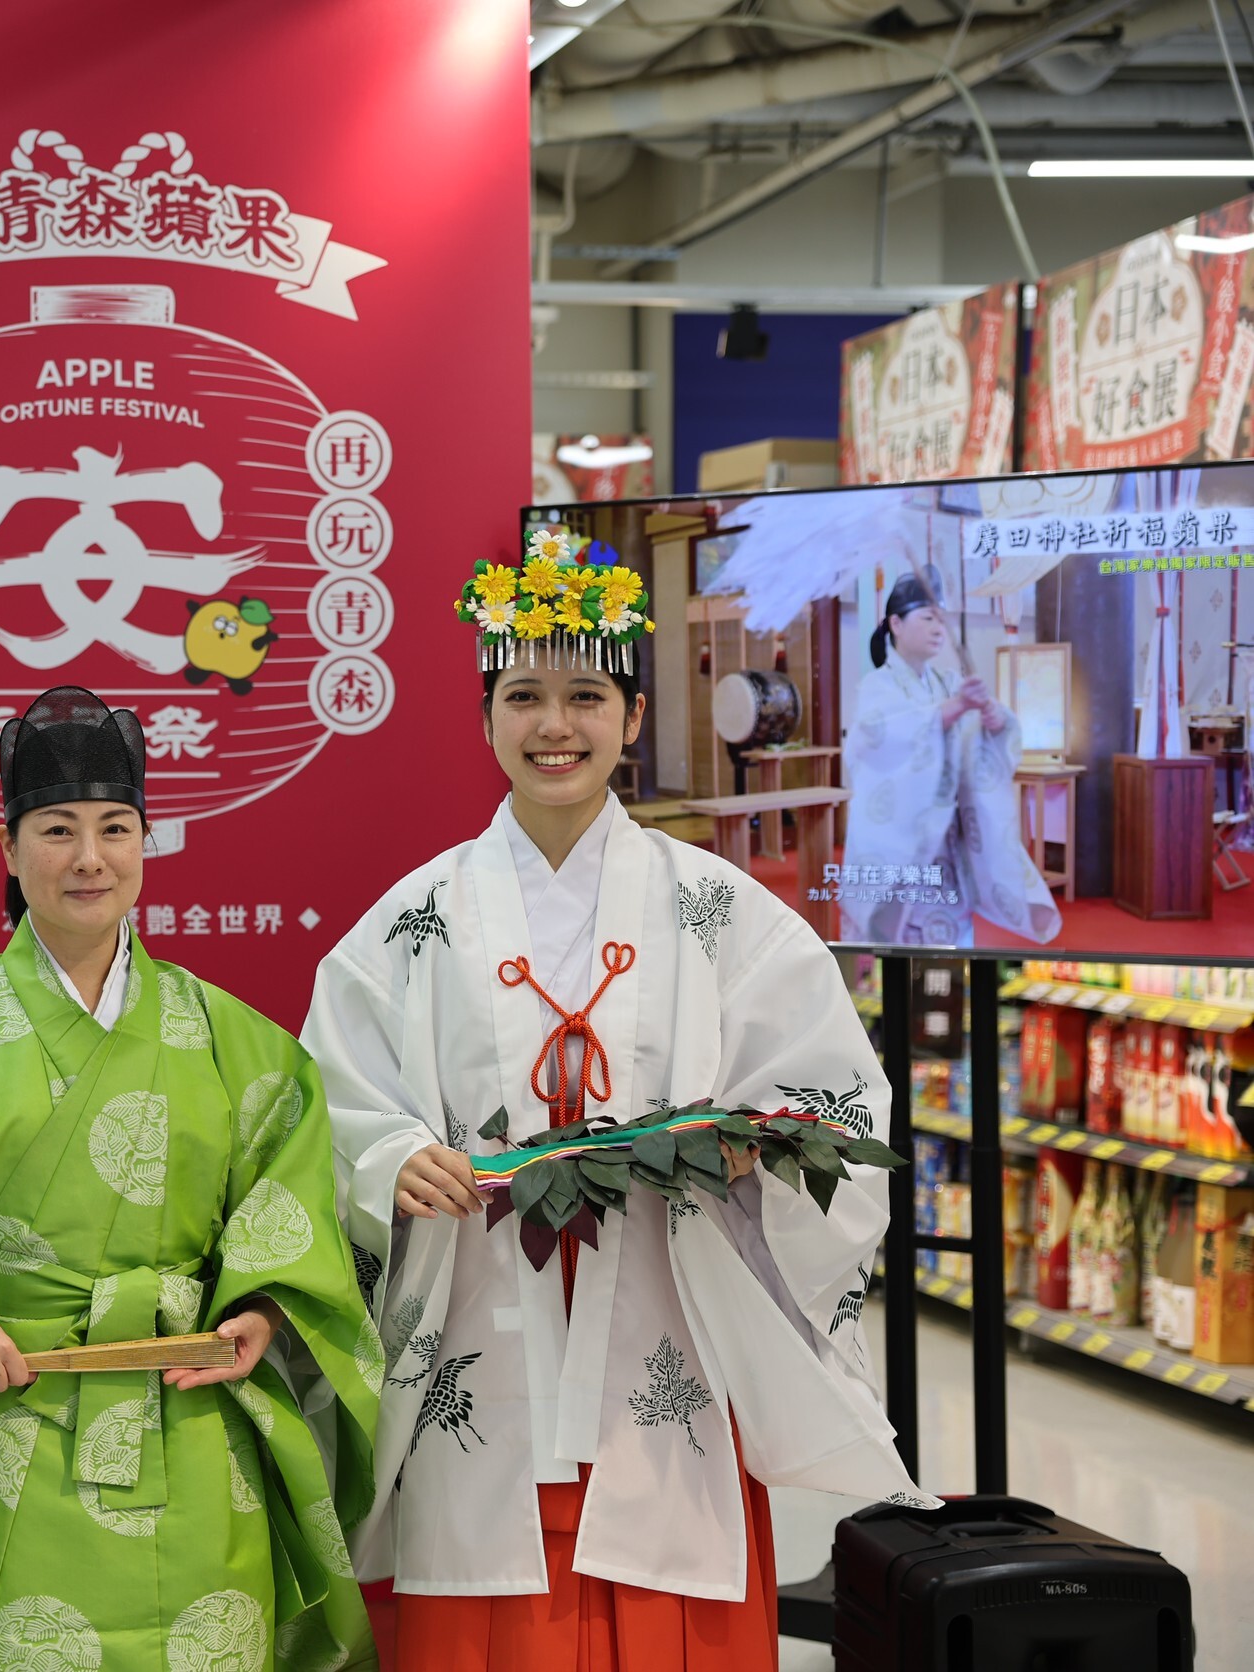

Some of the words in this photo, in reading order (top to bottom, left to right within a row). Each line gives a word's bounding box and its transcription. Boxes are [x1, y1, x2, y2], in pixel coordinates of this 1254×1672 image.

[1114, 272, 1170, 346] 日本
[36, 359, 155, 390] APPLE
[1094, 357, 1177, 436] 好食展
[100, 397, 205, 428] FESTIVAL
[973, 511, 1238, 558] 廣田神社祈福蘋果
[323, 434, 375, 715] 再玩青森
[822, 863, 944, 888] 只有在家樂福
